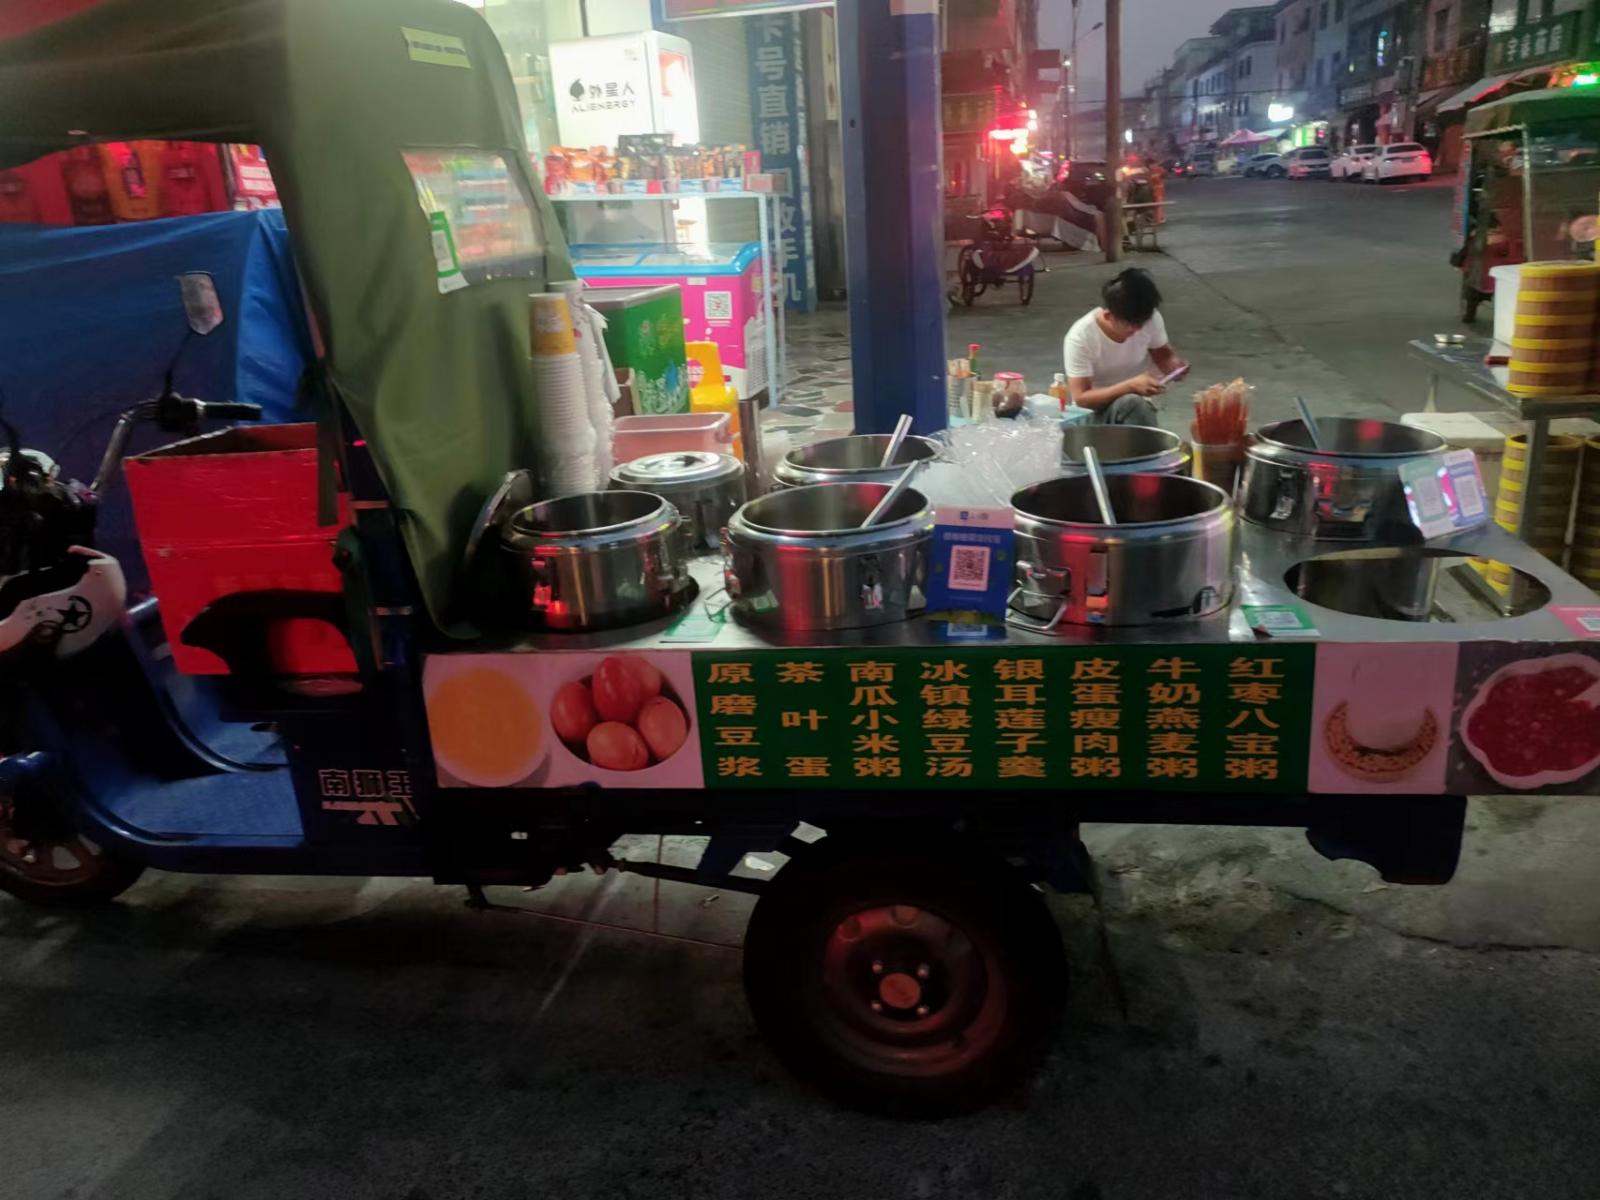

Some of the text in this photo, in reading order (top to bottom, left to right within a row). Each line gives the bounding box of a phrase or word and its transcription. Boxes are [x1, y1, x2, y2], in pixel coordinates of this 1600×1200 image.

[589, 81, 635, 99] 外星人
[706, 662, 763, 777] 原磨豆浆
[775, 662, 831, 777] 茶叶蛋
[846, 661, 901, 778] 南瓜小米粥
[919, 660, 973, 777] 冰镇绿豆汤
[992, 659, 1047, 778] 银耳莲子羹
[1069, 658, 1123, 778] 皮蛋瘦肉粥
[1145, 657, 1201, 779] 牛奶燕麦粥
[1225, 657, 1285, 780] 红枣八宝粥
